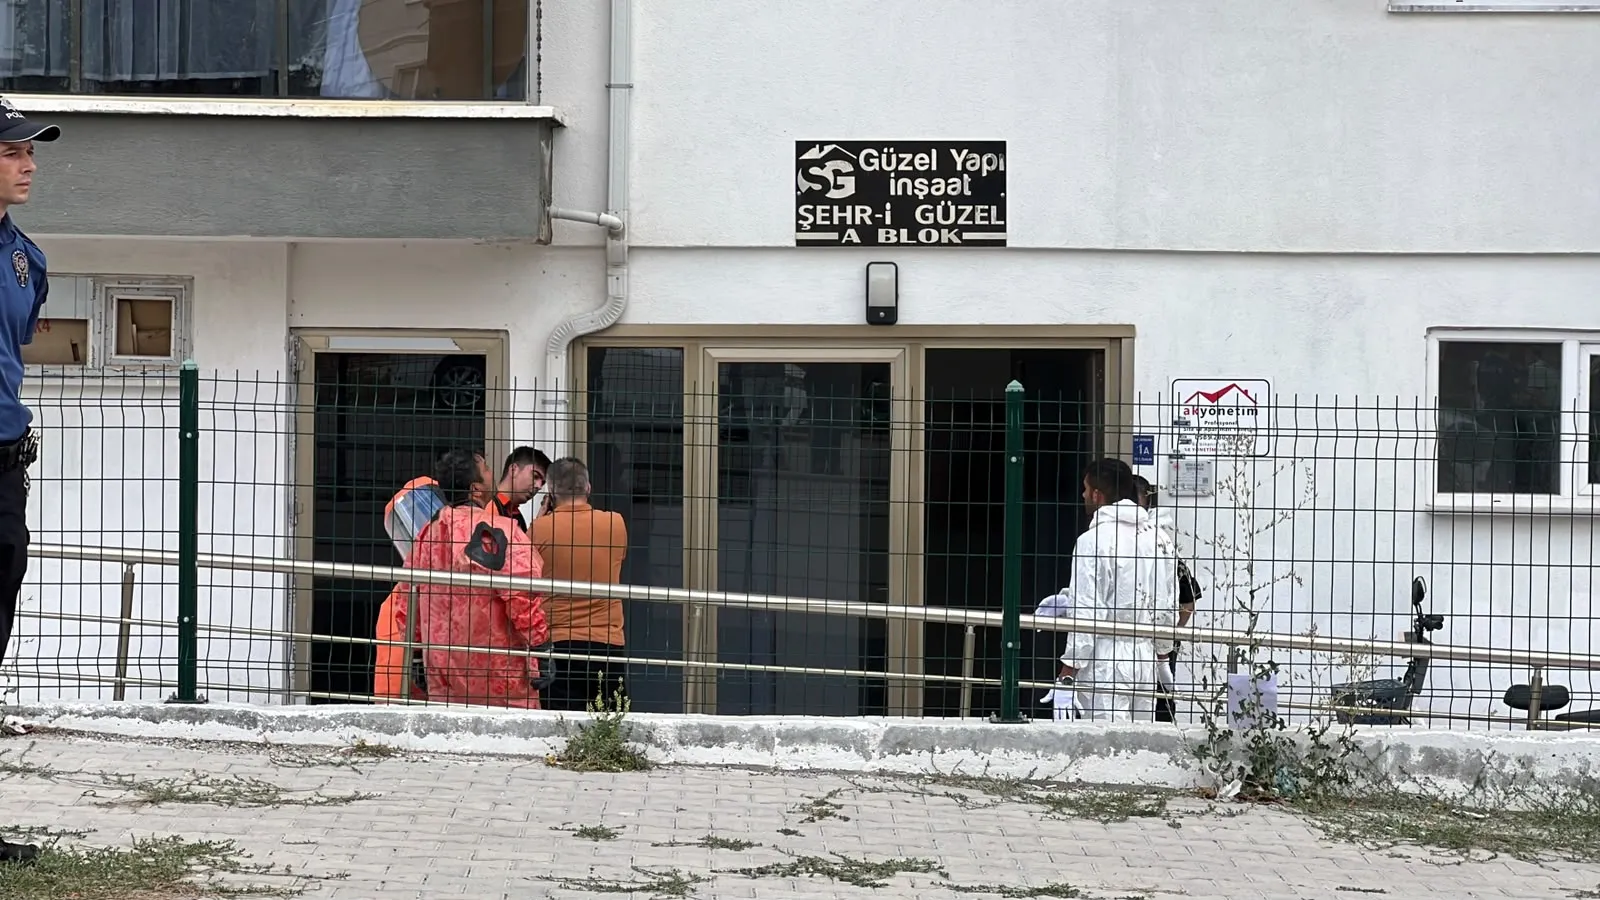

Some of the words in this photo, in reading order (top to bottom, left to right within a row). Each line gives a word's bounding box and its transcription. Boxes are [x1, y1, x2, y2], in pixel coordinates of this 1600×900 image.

[858, 147, 937, 172] Güzel
[950, 148, 1005, 177] Yapı
[915, 200, 1005, 225] GÜZEL
[841, 228, 861, 244] A
[877, 228, 962, 244] BLOK
